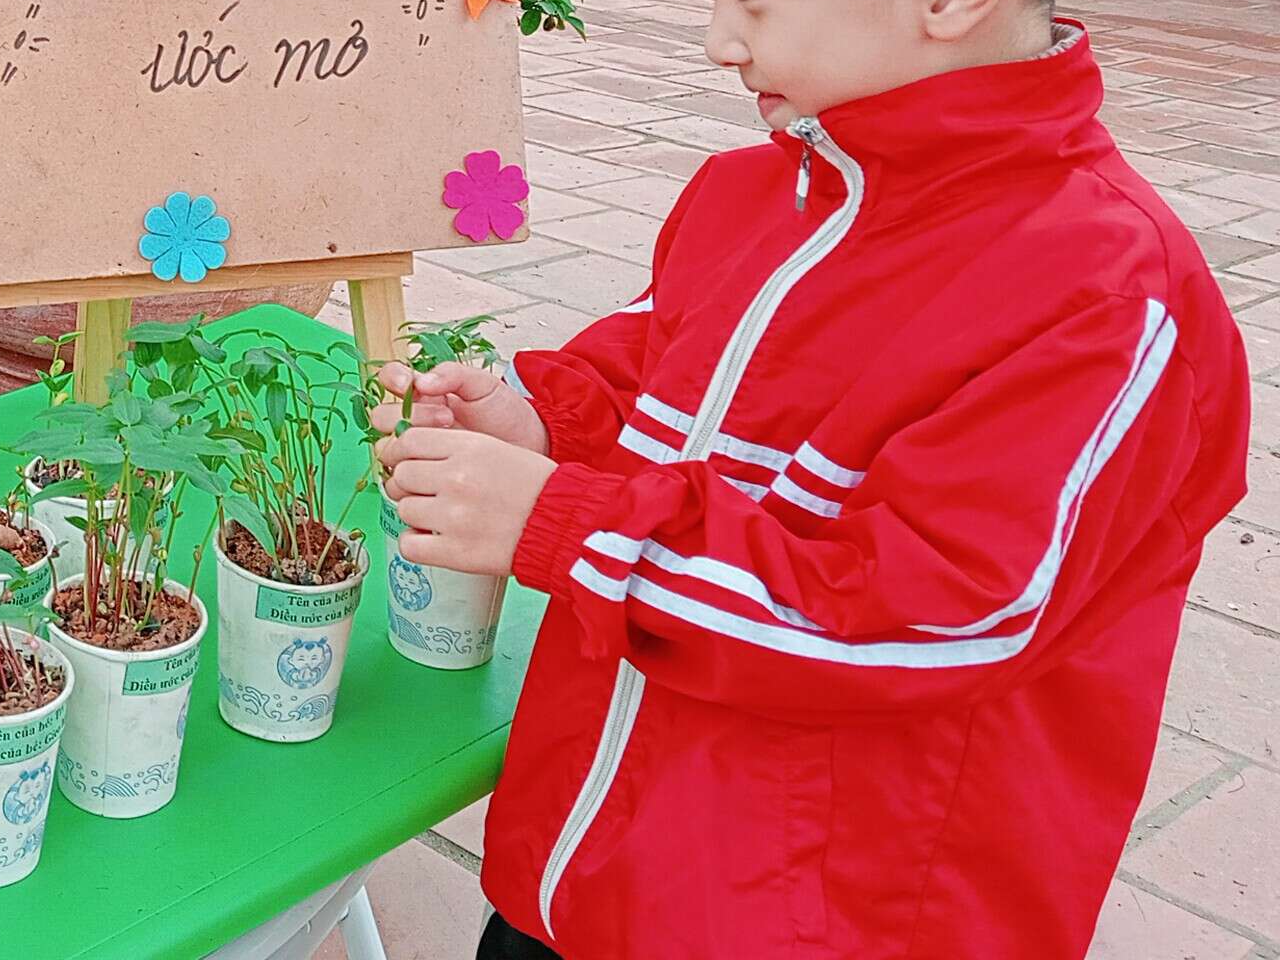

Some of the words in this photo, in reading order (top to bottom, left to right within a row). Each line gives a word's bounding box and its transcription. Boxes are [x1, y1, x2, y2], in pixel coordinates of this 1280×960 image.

[286, 594, 311, 608] Tên
[312, 594, 333, 608] của
[14, 725, 36, 741] của
[0, 746, 22, 761] của
